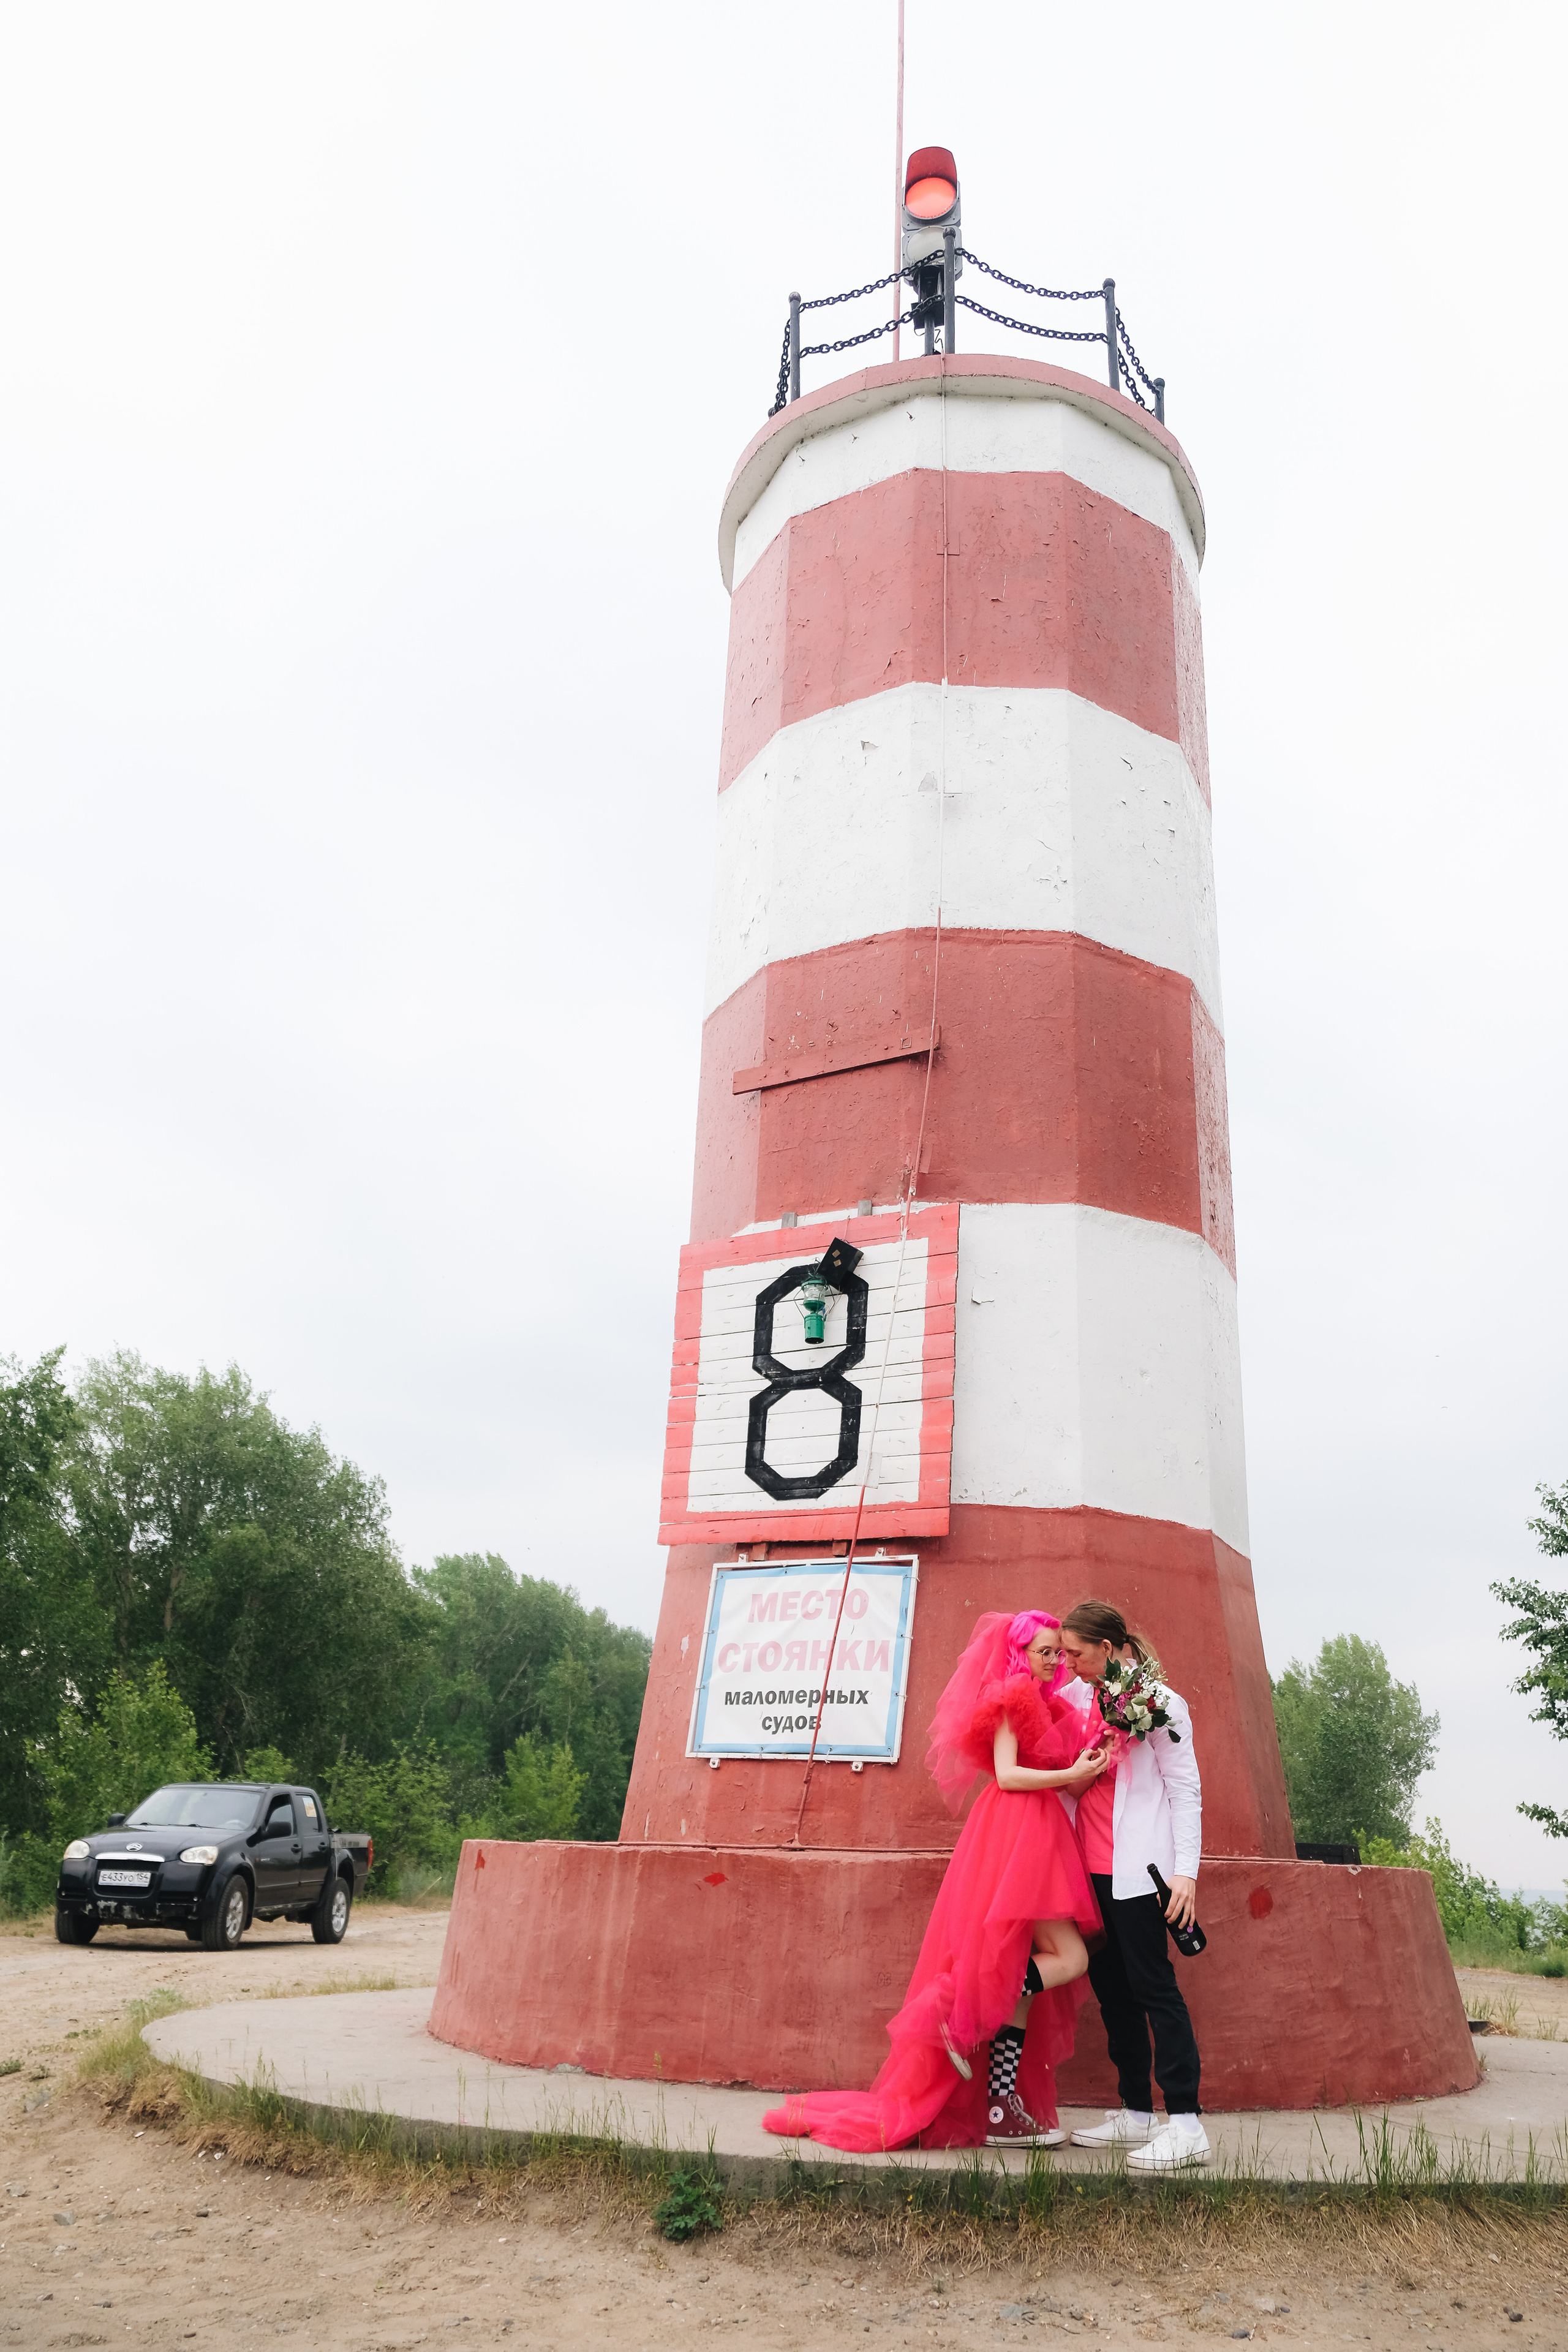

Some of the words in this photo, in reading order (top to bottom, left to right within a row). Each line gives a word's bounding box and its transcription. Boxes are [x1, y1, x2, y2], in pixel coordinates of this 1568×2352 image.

[744, 1263, 869, 1501] 8
[747, 1588, 870, 1623] МЕСТО
[717, 1639, 891, 1673] СТОЯНКИ
[724, 1688, 870, 1708] маломерных
[761, 1715, 821, 1735] судов
